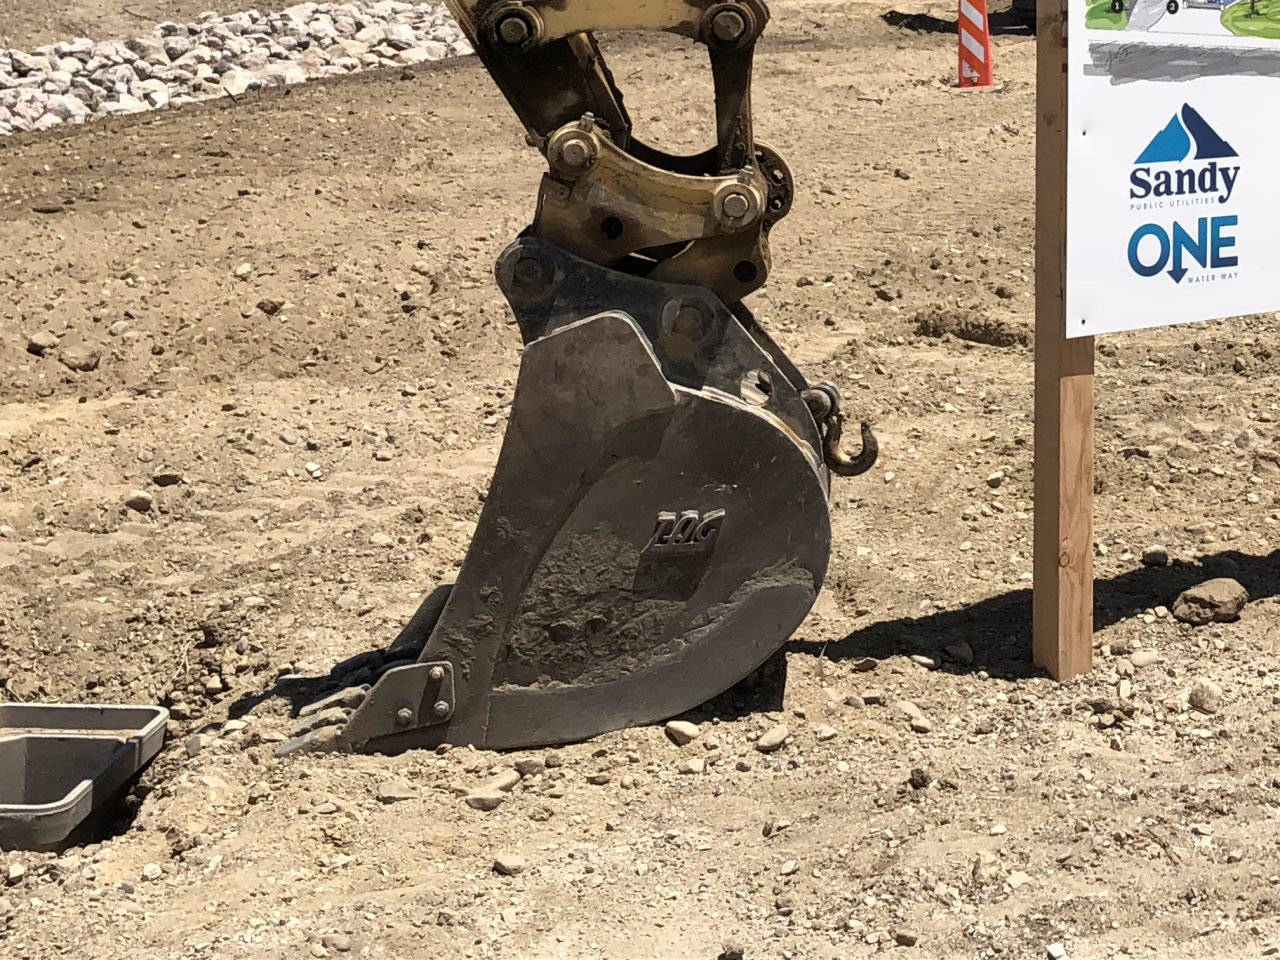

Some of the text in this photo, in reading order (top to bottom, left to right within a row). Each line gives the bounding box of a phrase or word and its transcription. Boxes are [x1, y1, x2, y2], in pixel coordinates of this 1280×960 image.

[1129, 161, 1241, 204] Sandy
[1130, 197, 1215, 211] PUBLIC UTILITIES
[1127, 215, 1238, 284] ONE
[1188, 272, 1238, 284] WATER WAY
